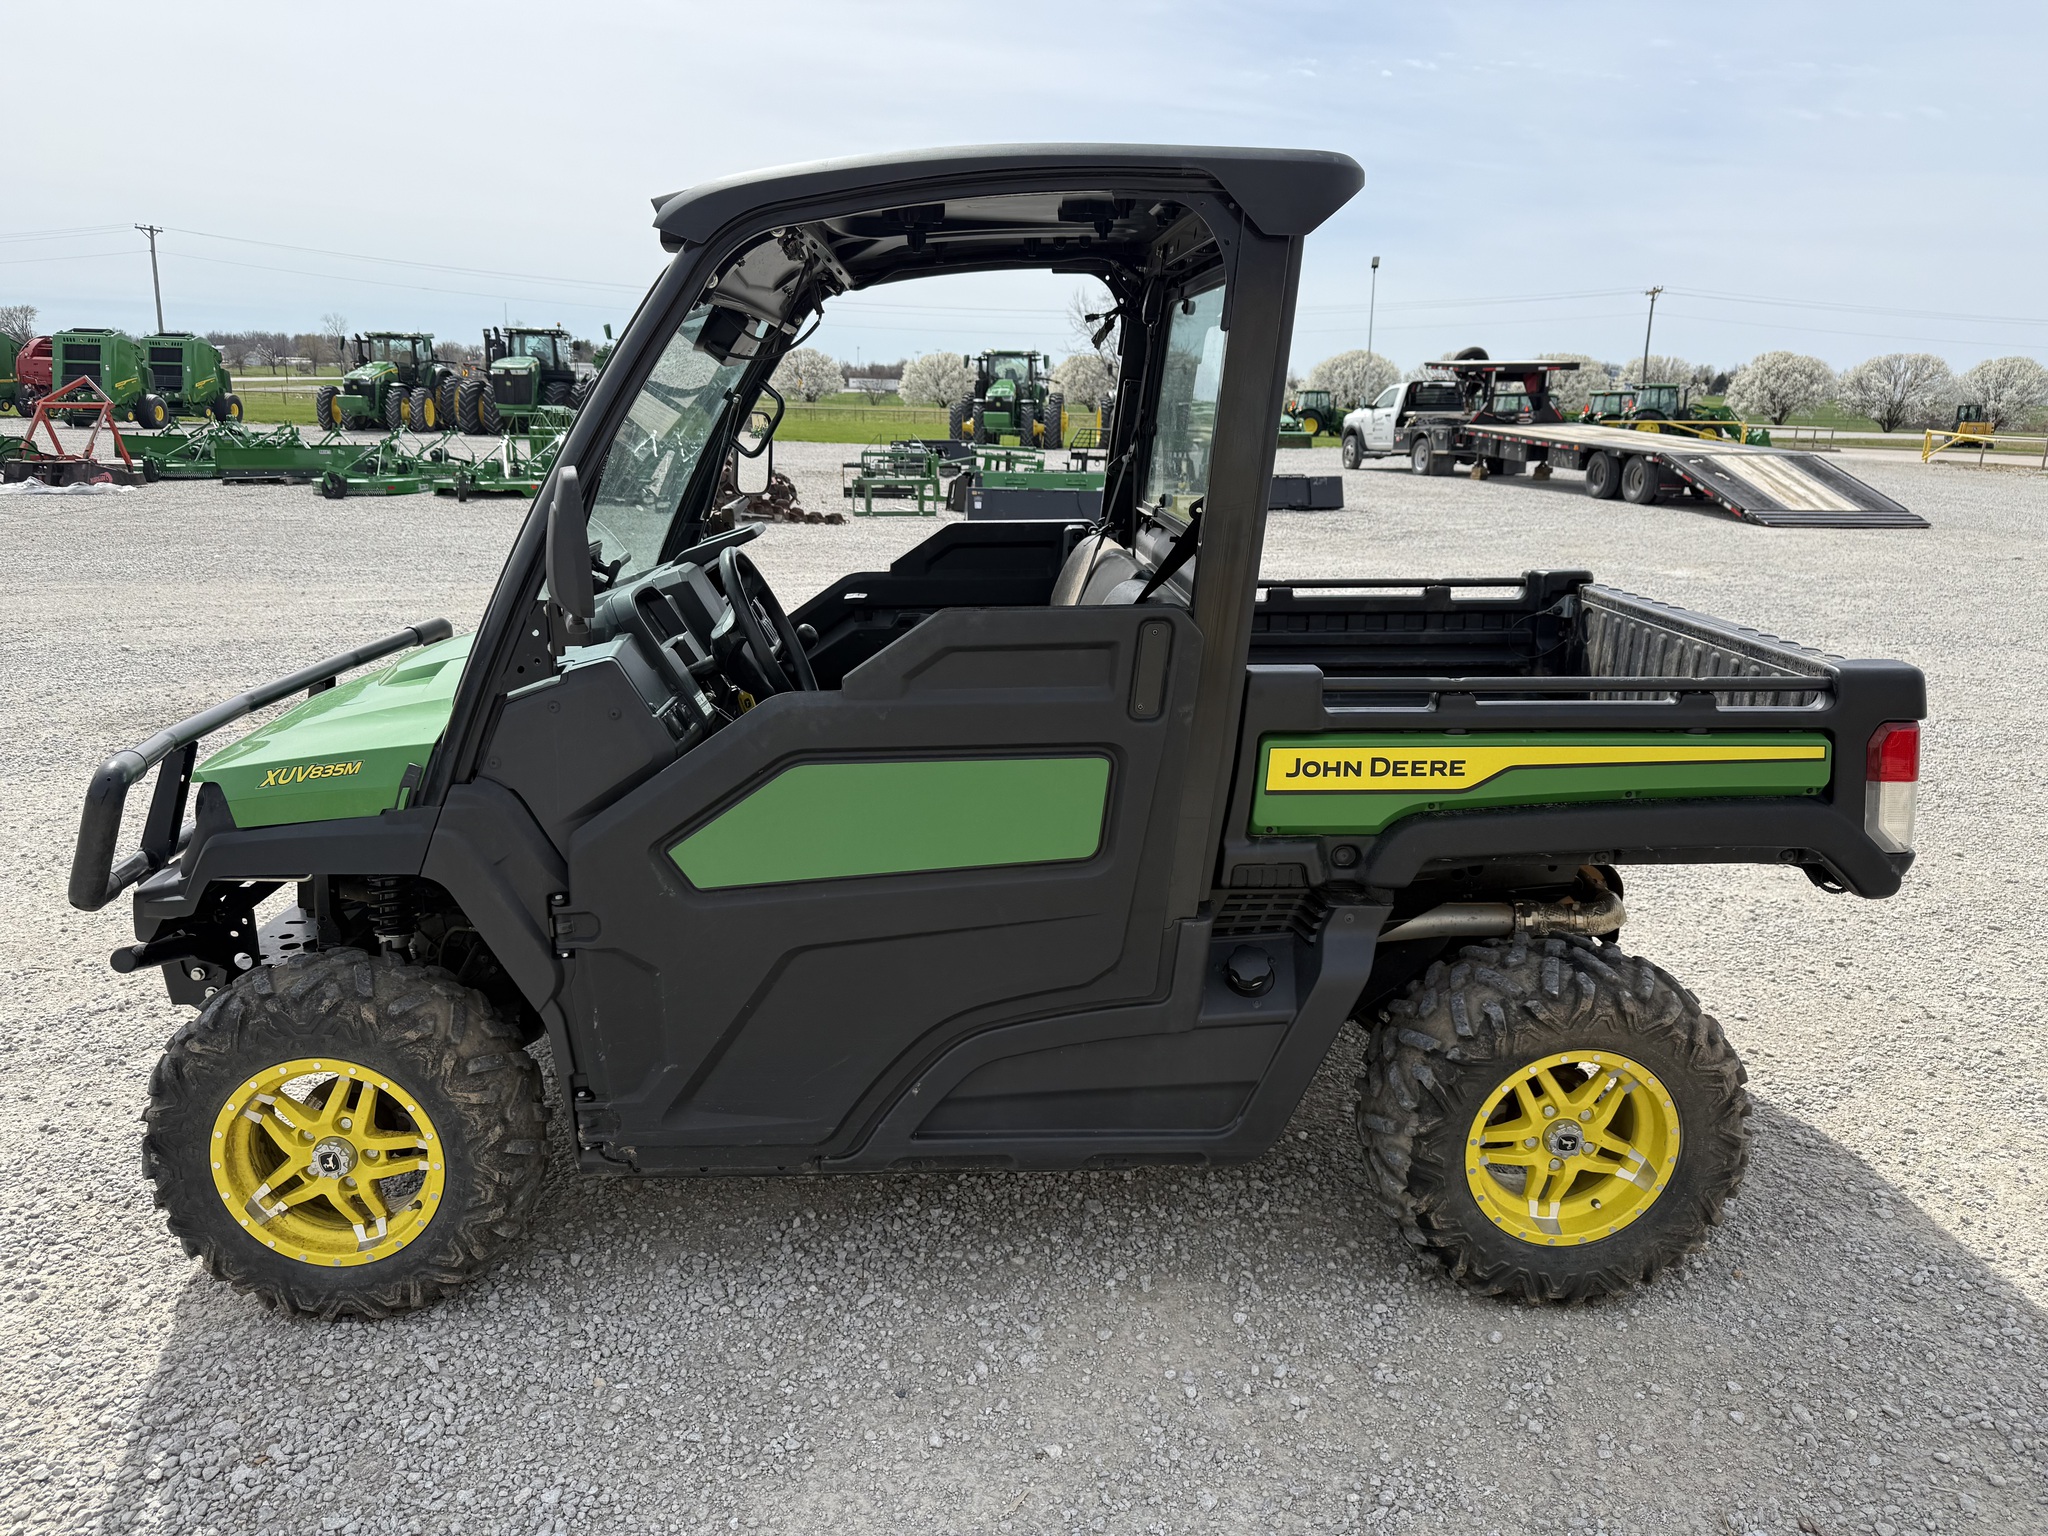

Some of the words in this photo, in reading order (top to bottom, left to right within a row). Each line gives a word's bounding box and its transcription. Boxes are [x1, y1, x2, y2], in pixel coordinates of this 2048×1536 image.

[258, 761, 363, 788] XUV835M
[1286, 758, 1362, 778] JOHN
[1370, 757, 1466, 777] DEERE
